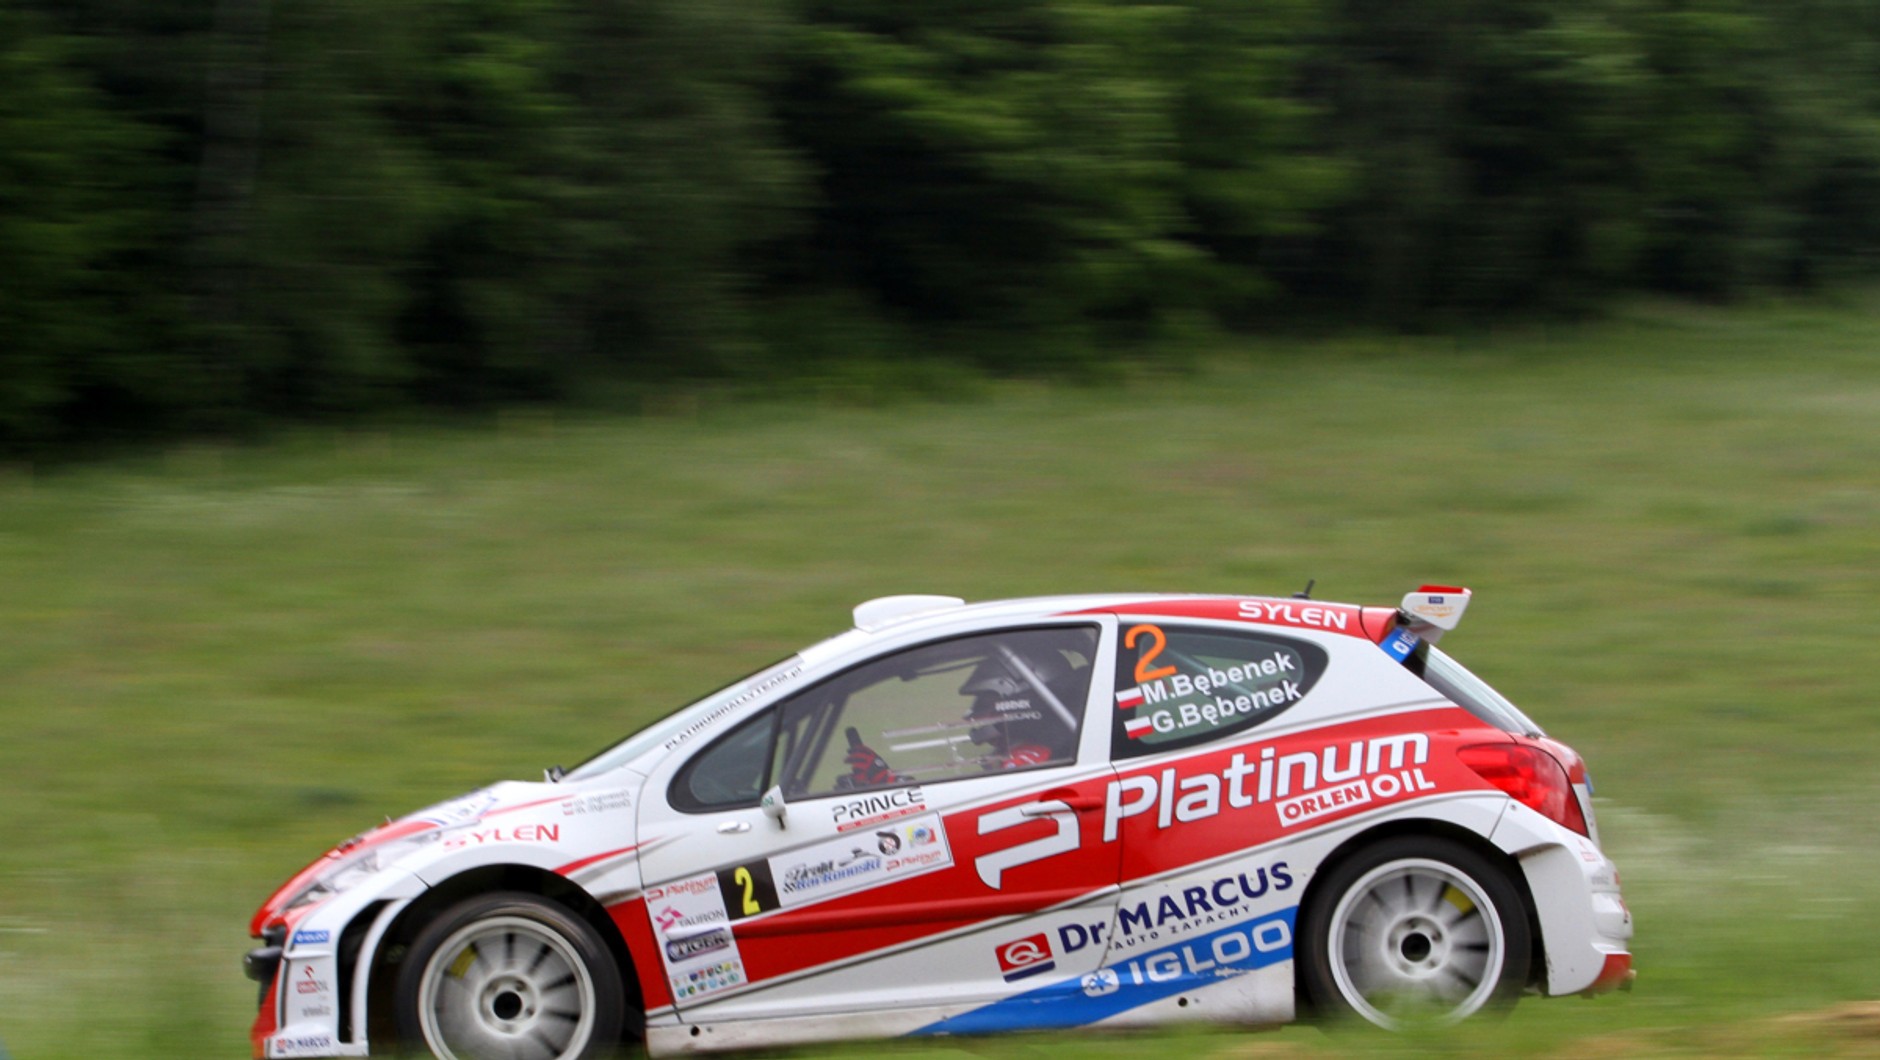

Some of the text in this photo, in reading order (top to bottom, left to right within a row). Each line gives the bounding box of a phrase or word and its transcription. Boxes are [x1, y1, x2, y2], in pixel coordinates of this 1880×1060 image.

[1238, 600, 1347, 630] SYLEN
[1124, 624, 1178, 683] 2
[1141, 651, 1296, 705] M.Bębenek
[1151, 679, 1304, 734] G.Bębenek
[832, 786, 926, 824] PRINCE
[1103, 732, 1429, 843] Platinum
[1283, 768, 1436, 820] ORLEN OIL
[444, 823, 560, 851] SYLEN
[734, 866, 760, 916] 2
[1118, 861, 1293, 936] MARCUS
[677, 908, 726, 928] TAURON
[677, 931, 727, 956] TIGER
[1114, 904, 1251, 951] AUTO ZAPACHY
[1129, 918, 1292, 985] IGLOO
